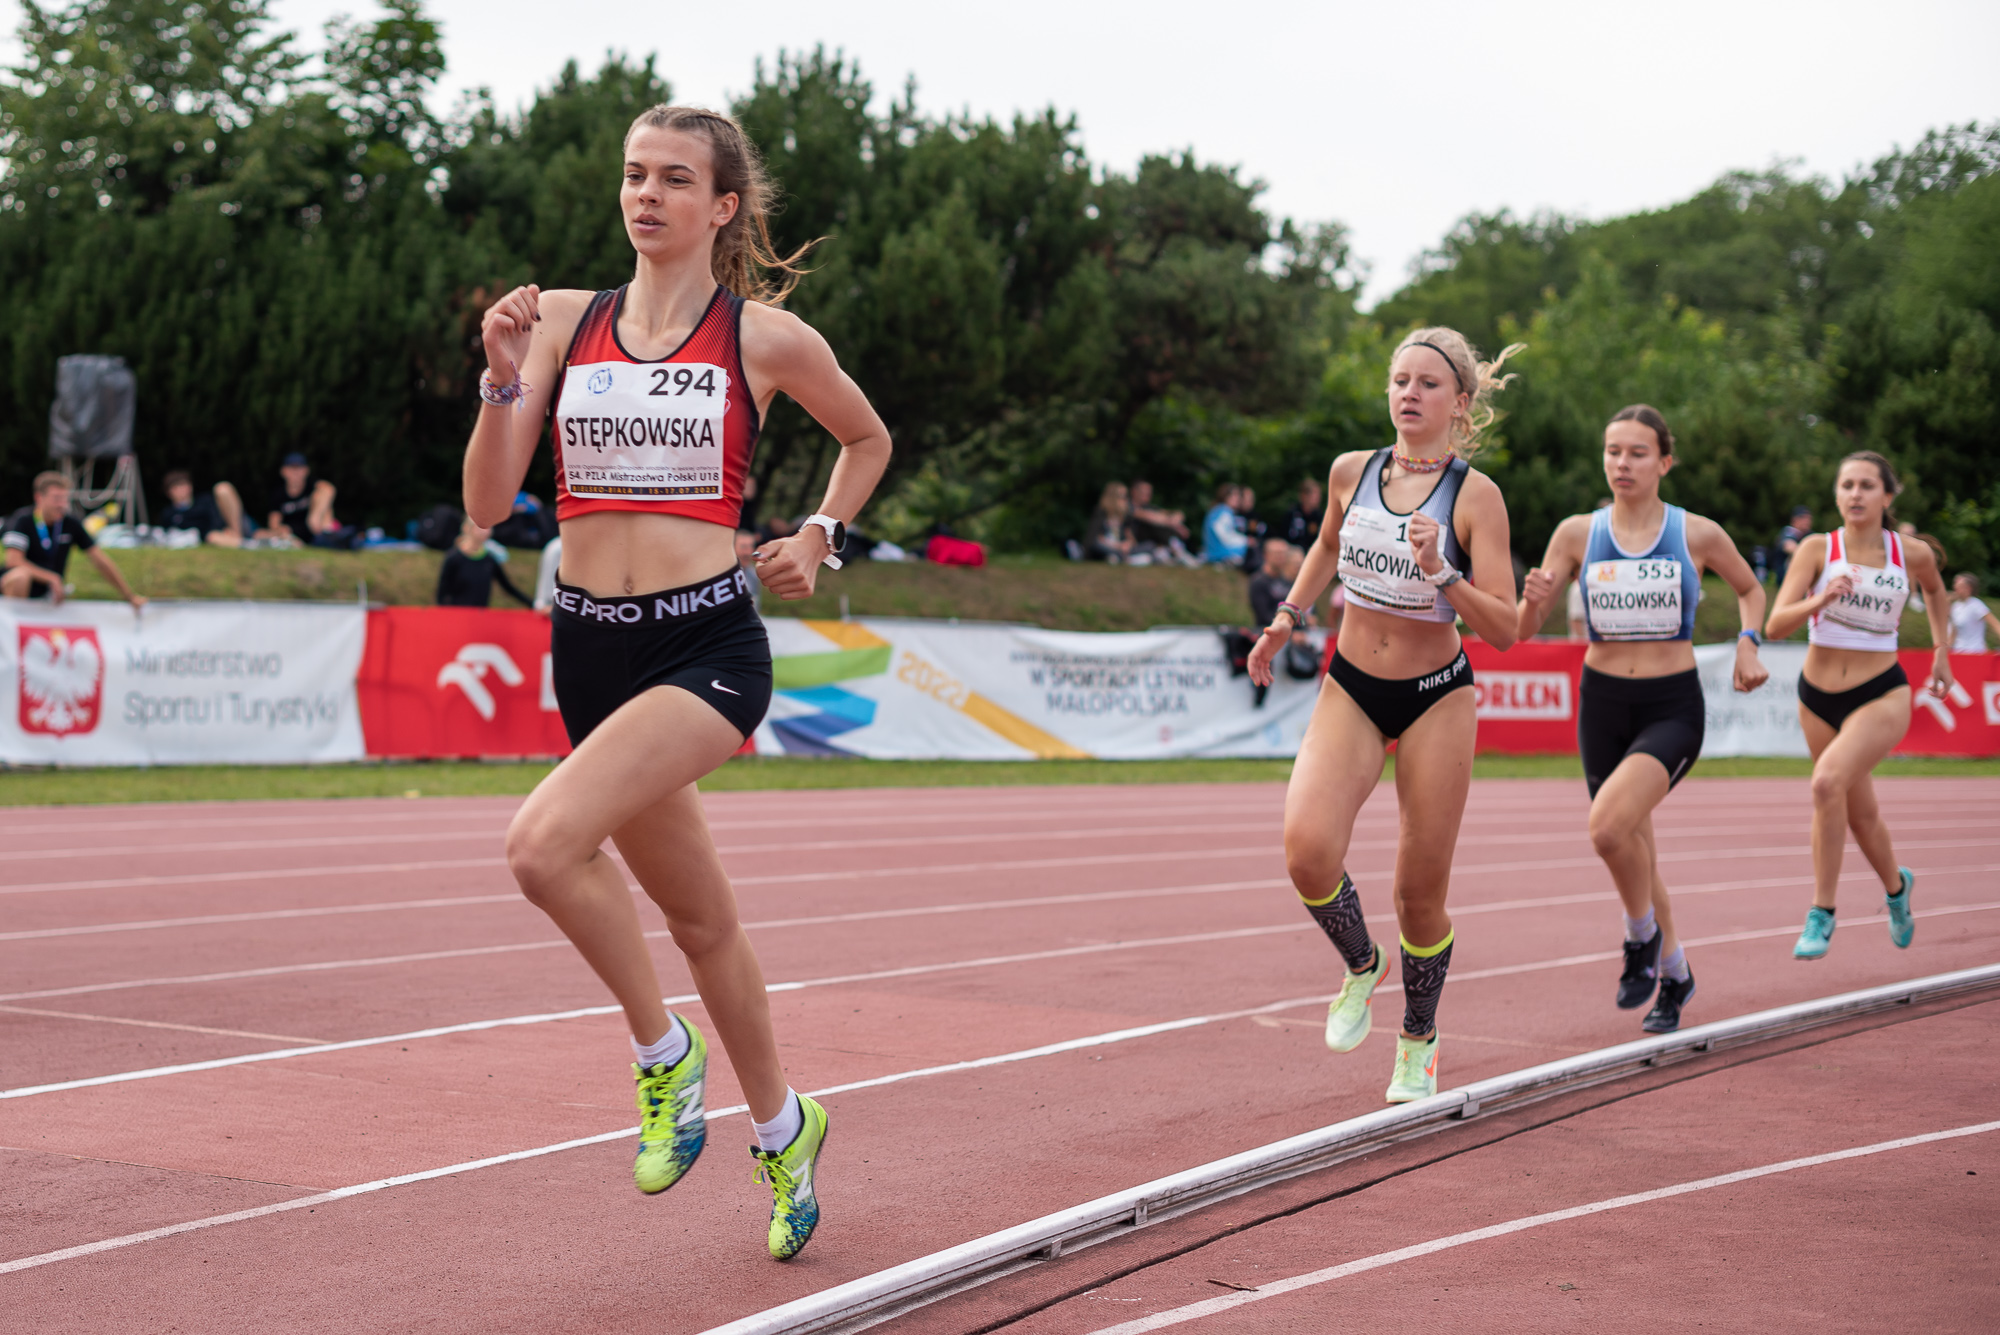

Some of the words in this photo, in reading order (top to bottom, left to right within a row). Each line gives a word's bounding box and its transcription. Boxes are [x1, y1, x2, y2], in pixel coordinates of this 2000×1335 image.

[648, 368, 716, 397] 294
[565, 417, 716, 453] STĘPKOWSKA
[568, 471, 583, 481] 54.
[585, 472, 607, 481] PZLA
[609, 472, 665, 482] Mistrzostwa
[667, 472, 697, 482] Polski
[700, 472, 720, 481] U18
[648, 486, 717, 495] 15-17.07.2022
[1637, 563, 1675, 580] 553
[580, 598, 643, 624] PRO
[655, 577, 735, 620] NIKE
[1591, 592, 1678, 610] KOZŁOWSKA
[1418, 669, 1452, 692] NIKE
[122, 690, 210, 731] Sportu
